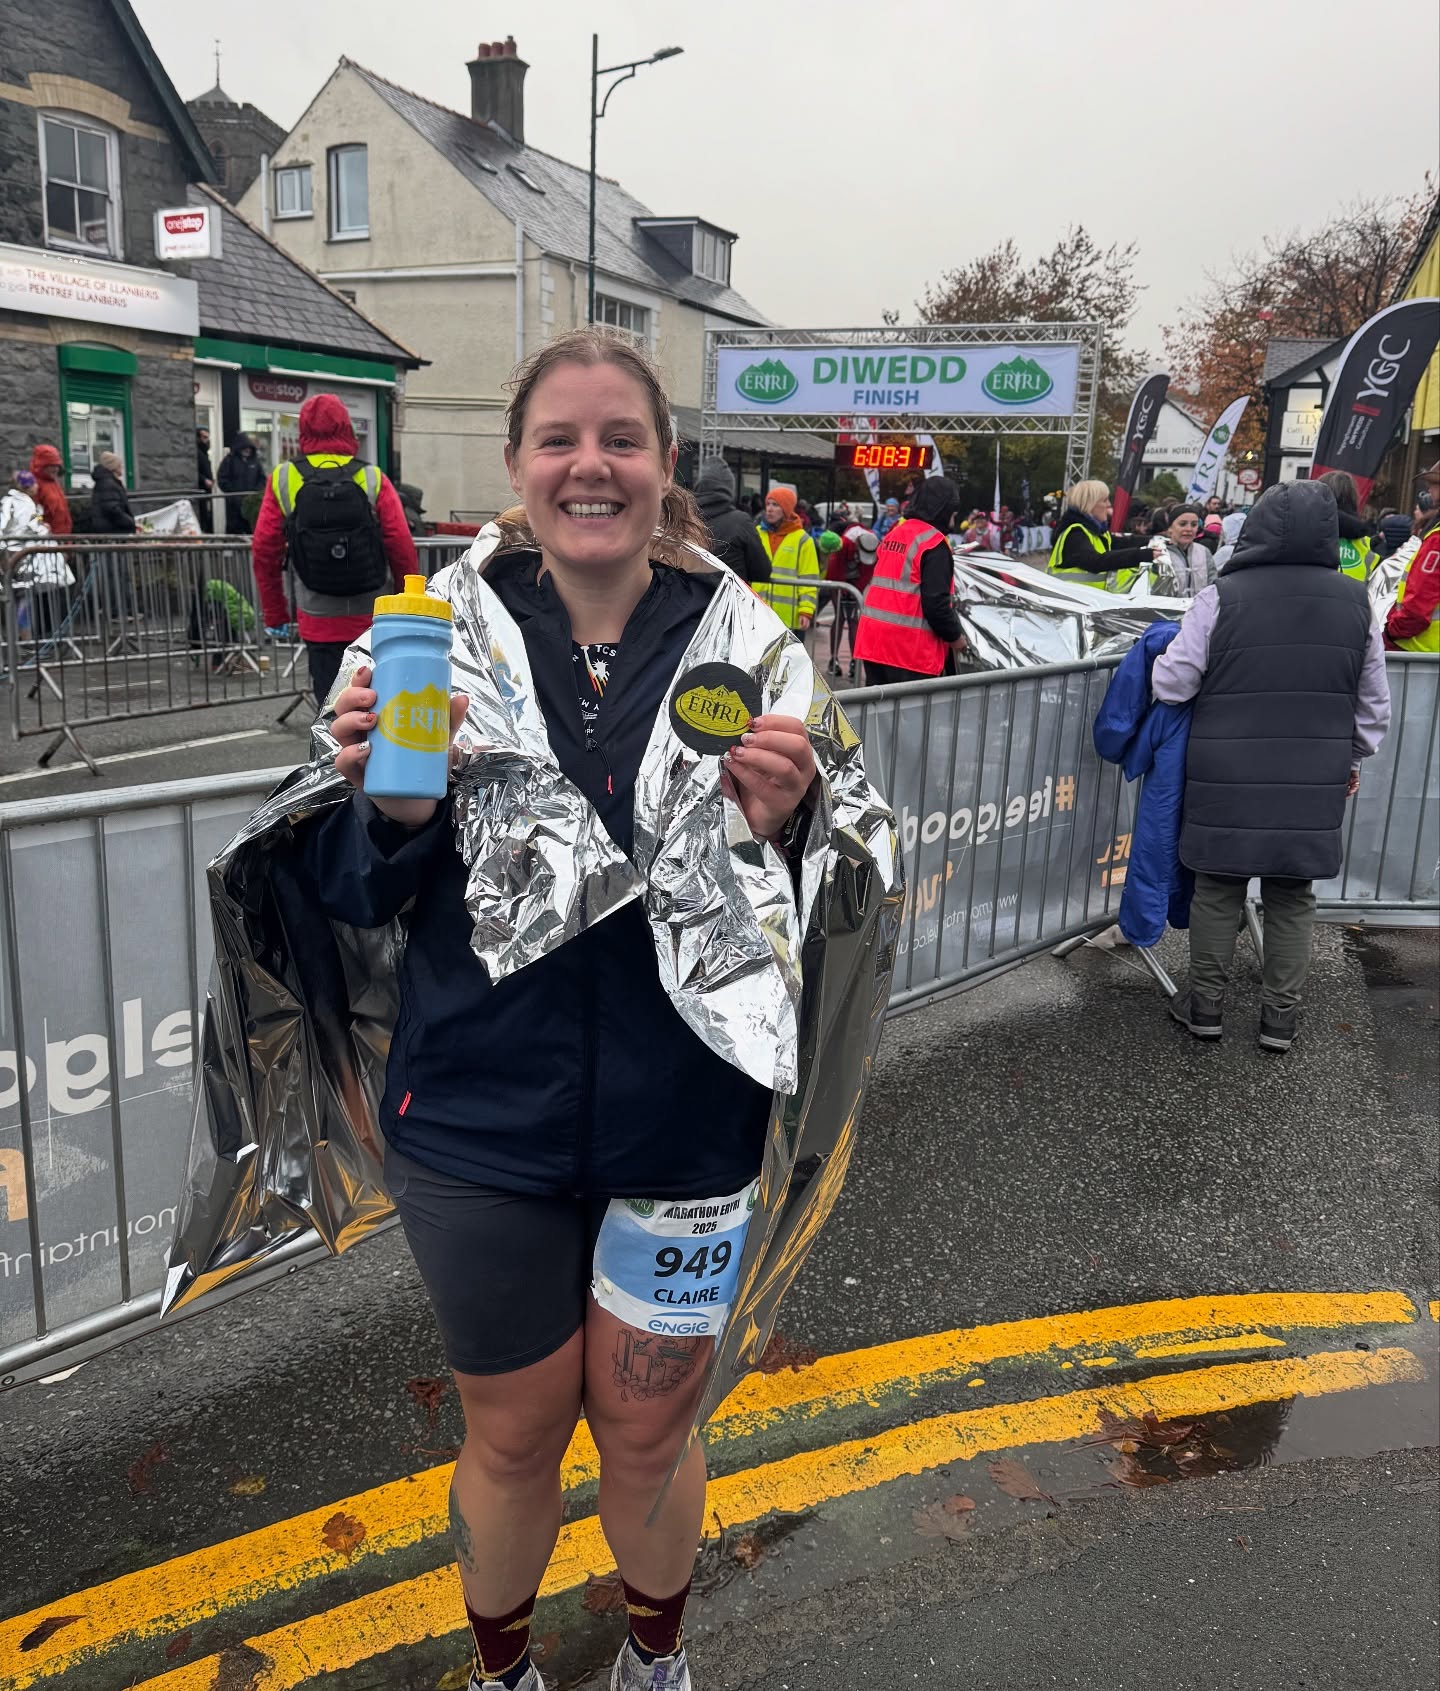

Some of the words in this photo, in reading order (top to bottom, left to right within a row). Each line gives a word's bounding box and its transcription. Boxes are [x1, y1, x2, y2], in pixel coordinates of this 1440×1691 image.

[26, 269, 46, 280] THE
[50, 273, 90, 289] VILLAGE
[94, 282, 106, 291] OF
[109, 283, 160, 300] LLANBERIS
[29, 283, 72, 299] PENTREF
[76, 291, 127, 308] LLANBERIS
[813, 355, 967, 384] DIWEDD
[1356, 334, 1411, 400] YGC
[853, 389, 919, 406] FINISH
[595, 645, 617, 657] TCS
[393, 705, 448, 735] ERYR
[663, 1206, 718, 1220] MARATHON
[720, 1198, 741, 1214] ERYRI
[691, 1221, 717, 1235] 2025
[653, 1240, 732, 1280] 949
[653, 1286, 720, 1305] CLAIRE
